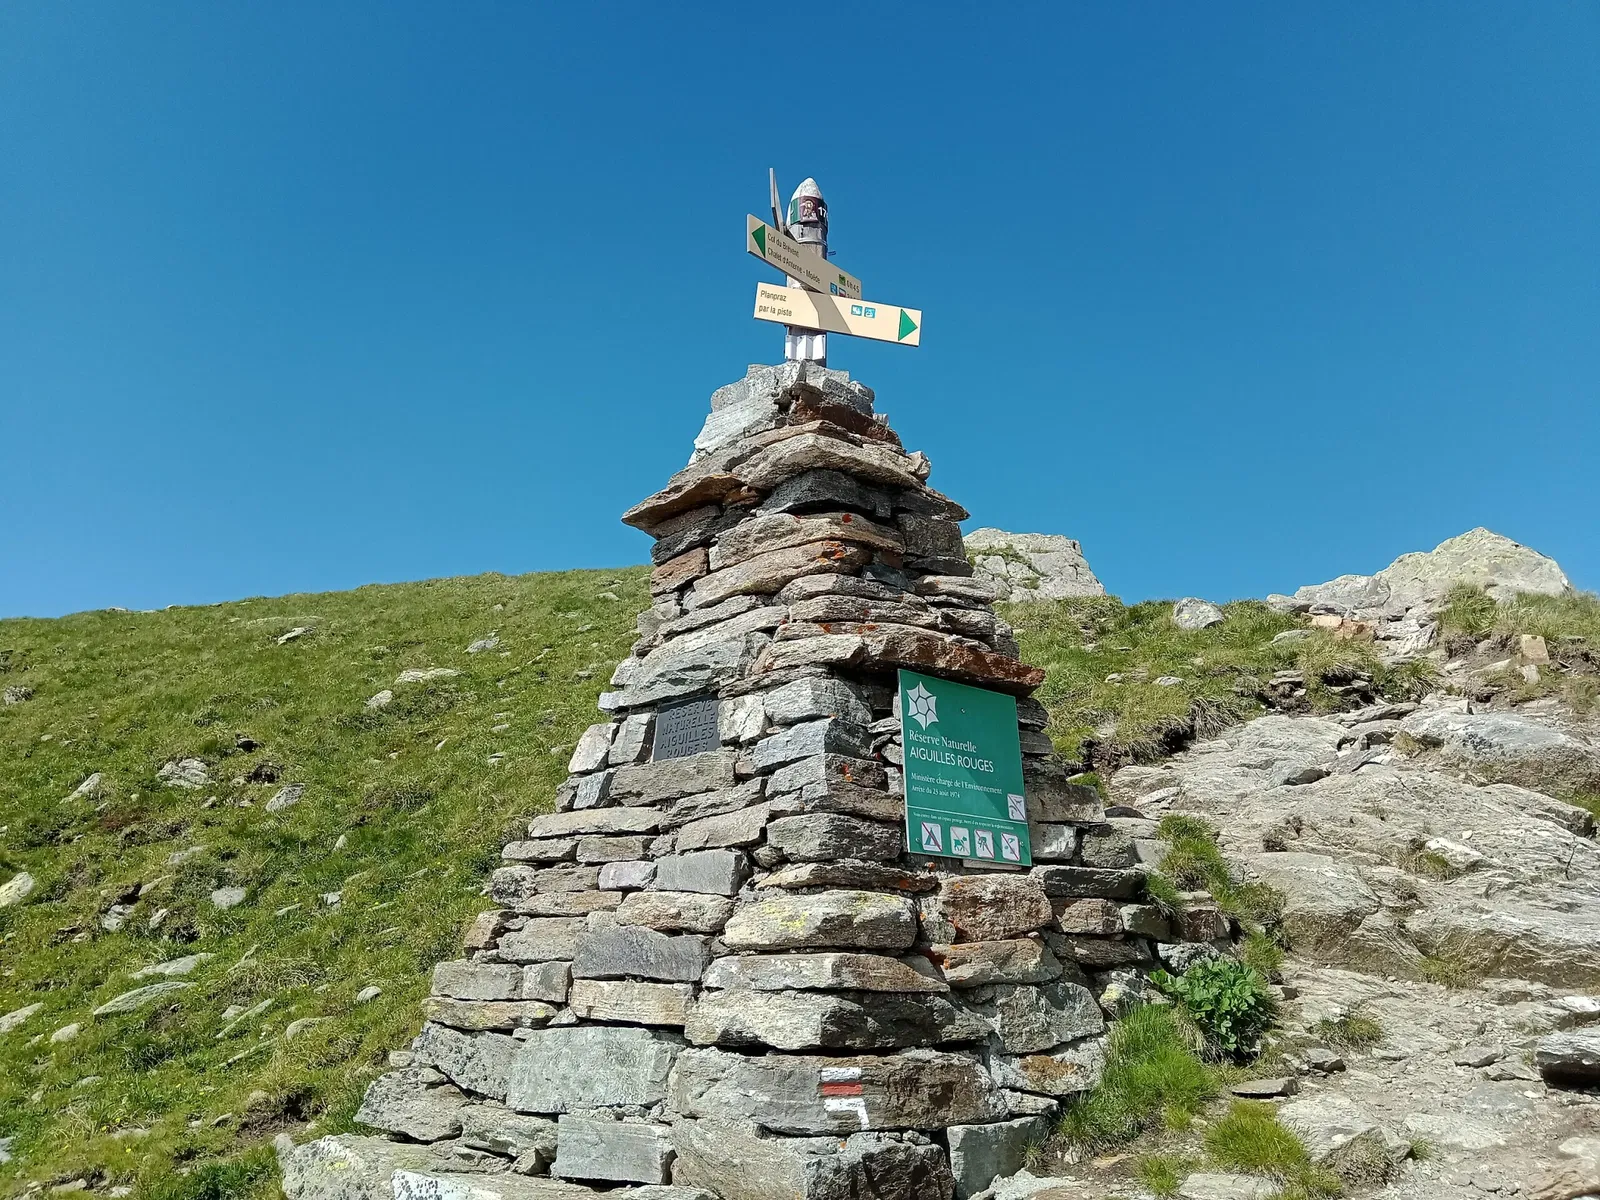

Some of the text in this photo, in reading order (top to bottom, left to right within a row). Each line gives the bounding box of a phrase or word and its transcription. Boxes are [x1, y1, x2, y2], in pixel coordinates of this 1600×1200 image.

[767, 232, 776, 243] Col
[776, 238, 782, 248] du
[767, 247, 782, 261] Chalet
[760, 289, 787, 302] Planpraz
[758, 304, 793, 317] par la piste
[668, 699, 713, 721] RESERVE
[662, 712, 716, 736] NATURELLE
[660, 727, 714, 750] AIGUILLES
[909, 729, 977, 753] Réserve Naturelle
[666, 741, 709, 758] ROUGES
[909, 746, 994, 773] AIGUILLES ROUGES
[911, 772, 936, 784] Ministère
[936, 776, 953, 788] chargé
[953, 780, 961, 788] de
[926, 786, 932, 794] du
